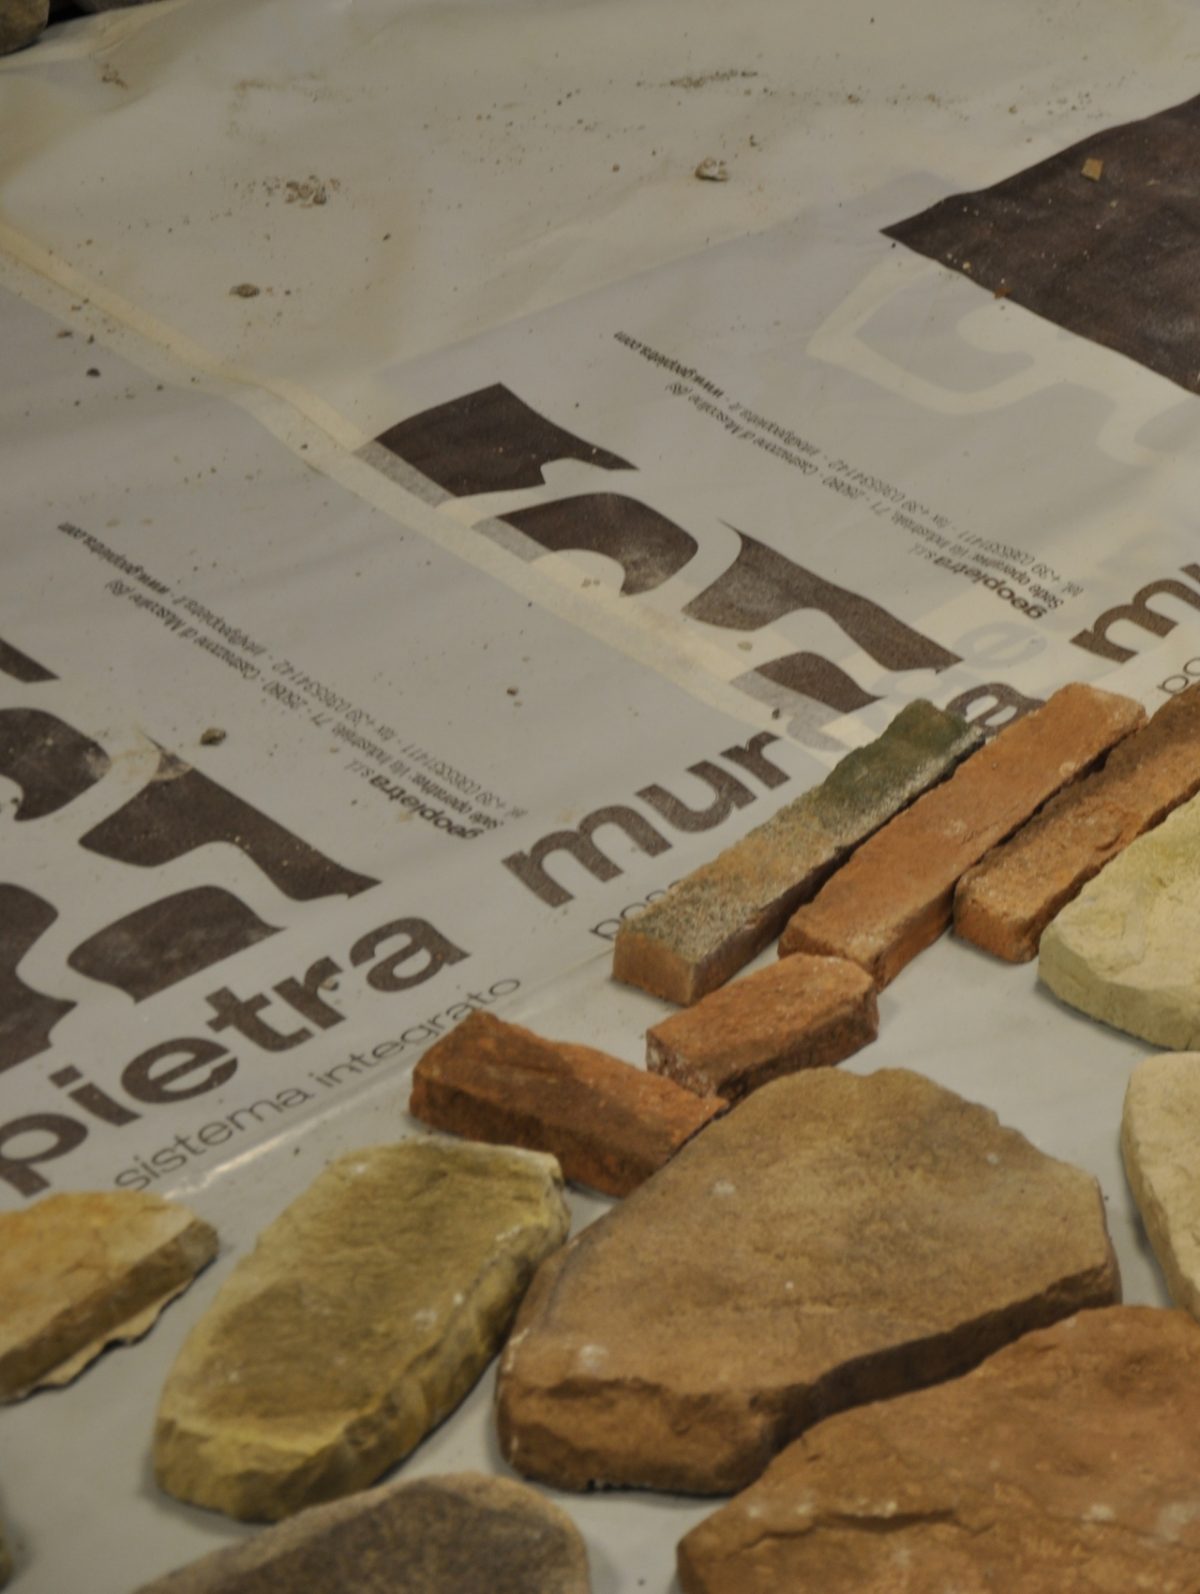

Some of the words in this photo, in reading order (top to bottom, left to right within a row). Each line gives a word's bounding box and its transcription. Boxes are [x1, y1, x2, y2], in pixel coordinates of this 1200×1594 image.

[933, 556, 1047, 619] geopietra
[369, 773, 484, 841] geopietra
[0, 916, 472, 1197] pietra
[501, 730, 792, 908] mur
[115, 1086, 314, 1191] sistema
[308, 978, 521, 1088] integrato
